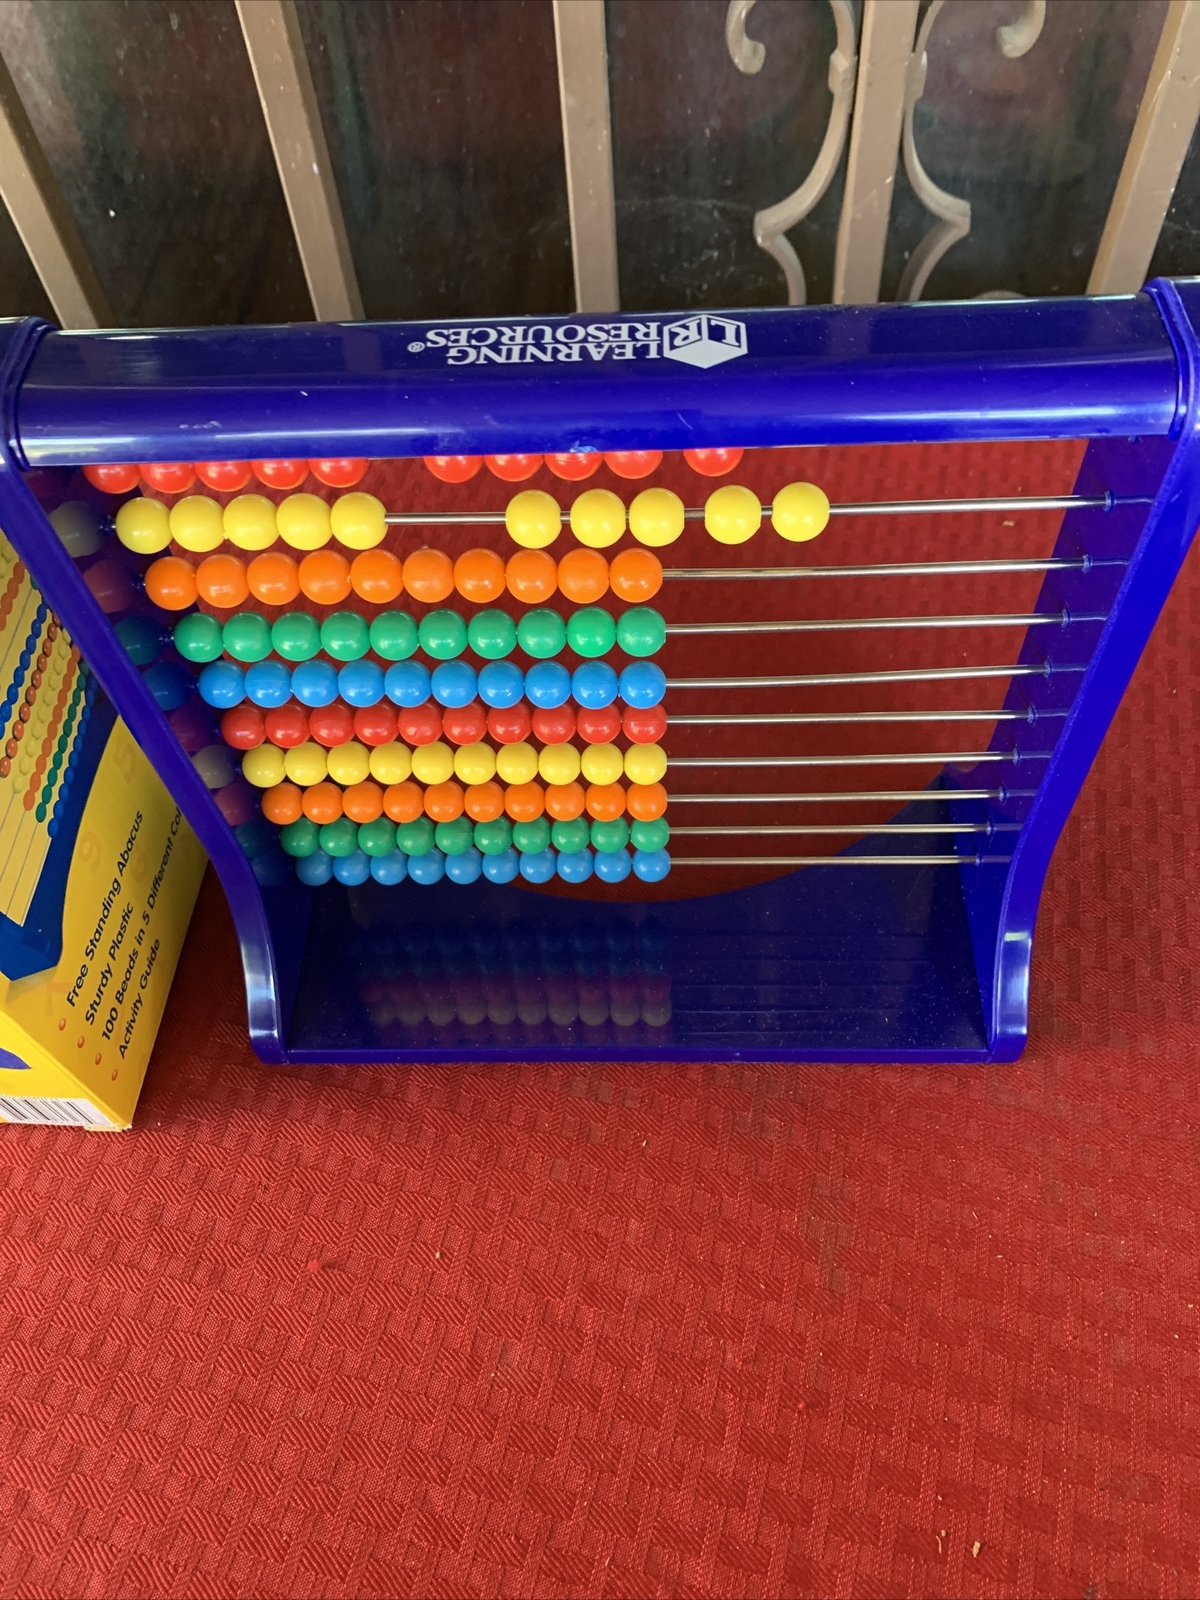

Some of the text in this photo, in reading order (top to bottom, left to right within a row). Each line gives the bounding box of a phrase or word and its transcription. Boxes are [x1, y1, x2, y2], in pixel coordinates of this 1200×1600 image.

[446, 340, 661, 365] LEARNING
[67, 811, 143, 1007] Free Standing Abacus
[85, 902, 134, 1025] Sturdy Plastic
[102, 1007, 118, 1040] 100
[115, 948, 138, 1005] Beads
[135, 927, 145, 946] in
[142, 910, 150, 925] 5
[147, 837, 174, 910] Different
[170, 806, 182, 836] Col
[118, 993, 143, 1059] Activity
[139, 938, 160, 990] Guide
